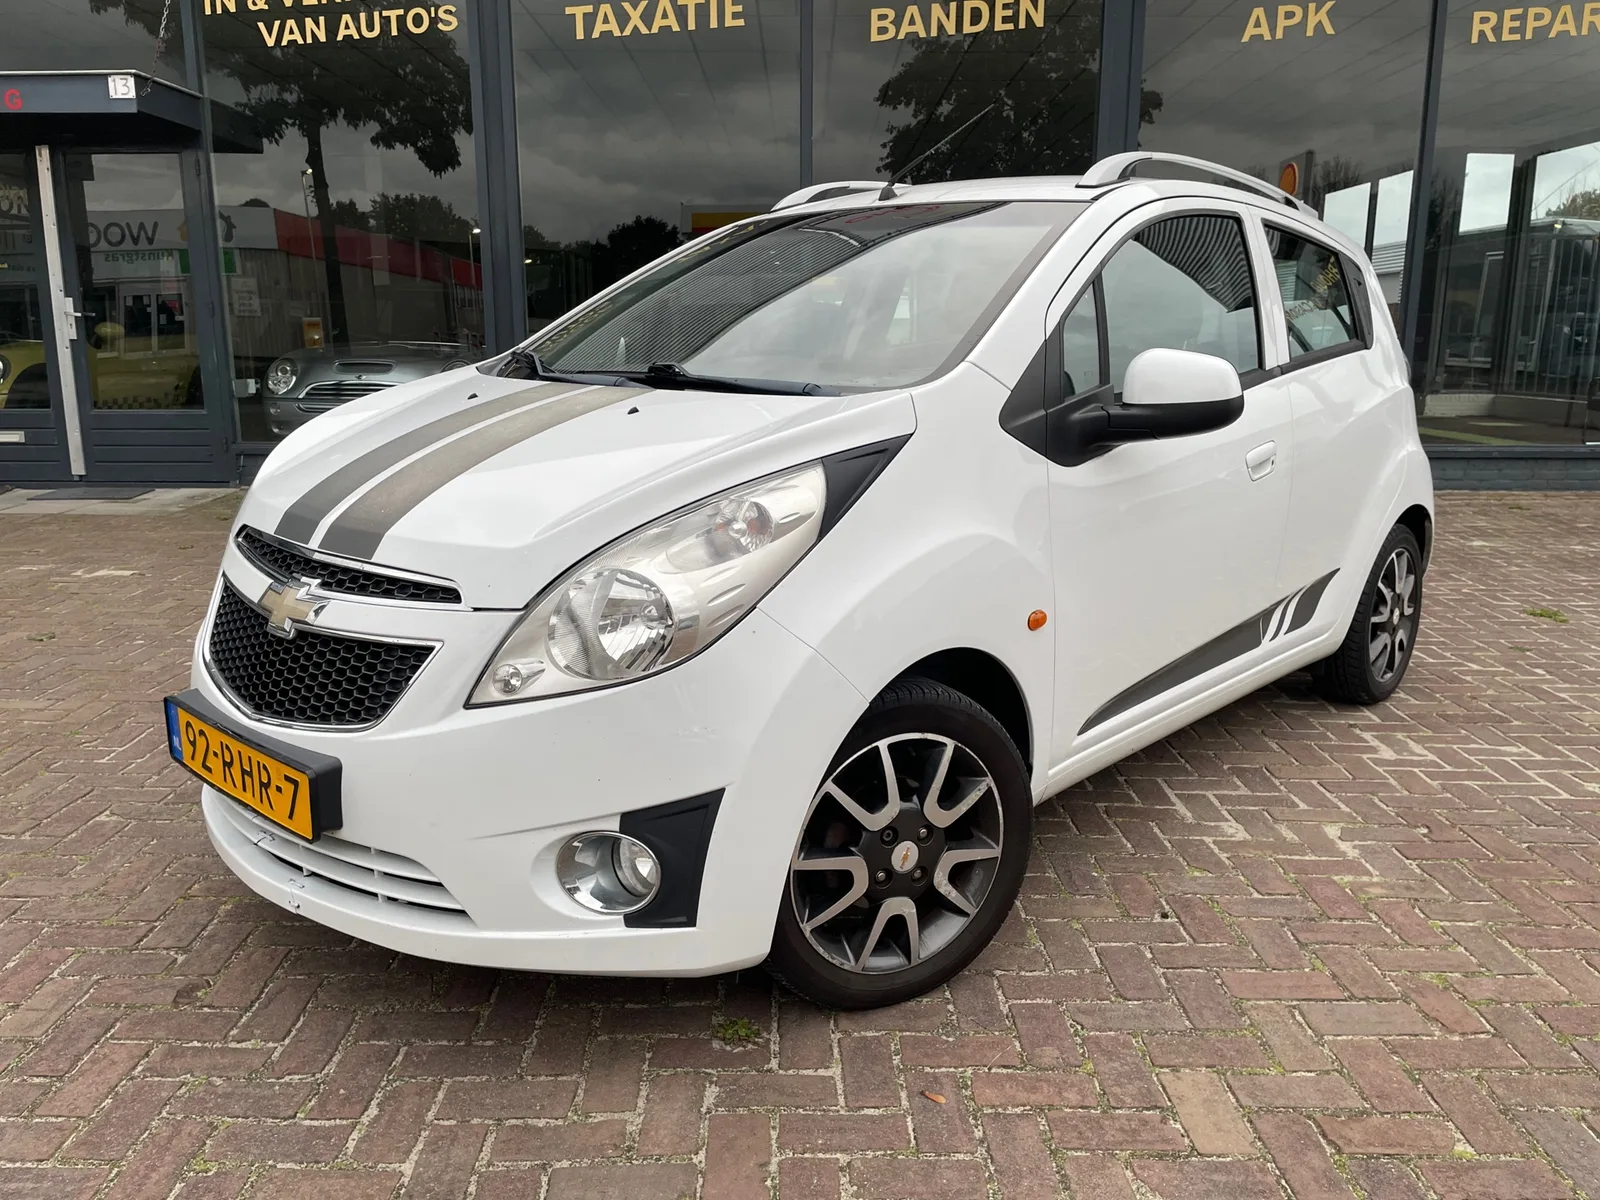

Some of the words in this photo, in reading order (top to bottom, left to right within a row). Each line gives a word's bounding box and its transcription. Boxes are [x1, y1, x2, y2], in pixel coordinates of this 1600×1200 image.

[257, 16, 327, 47] VAN
[336, 5, 459, 41] AUTO'S
[565, 0, 746, 40] TAXATIE
[870, 0, 1045, 42] BANDEN
[1241, 1, 1336, 43] APK
[1471, 2, 1600, 44] REPAR
[111, 77, 131, 96] 13
[185, 719, 301, 821] 92-RHR-7
